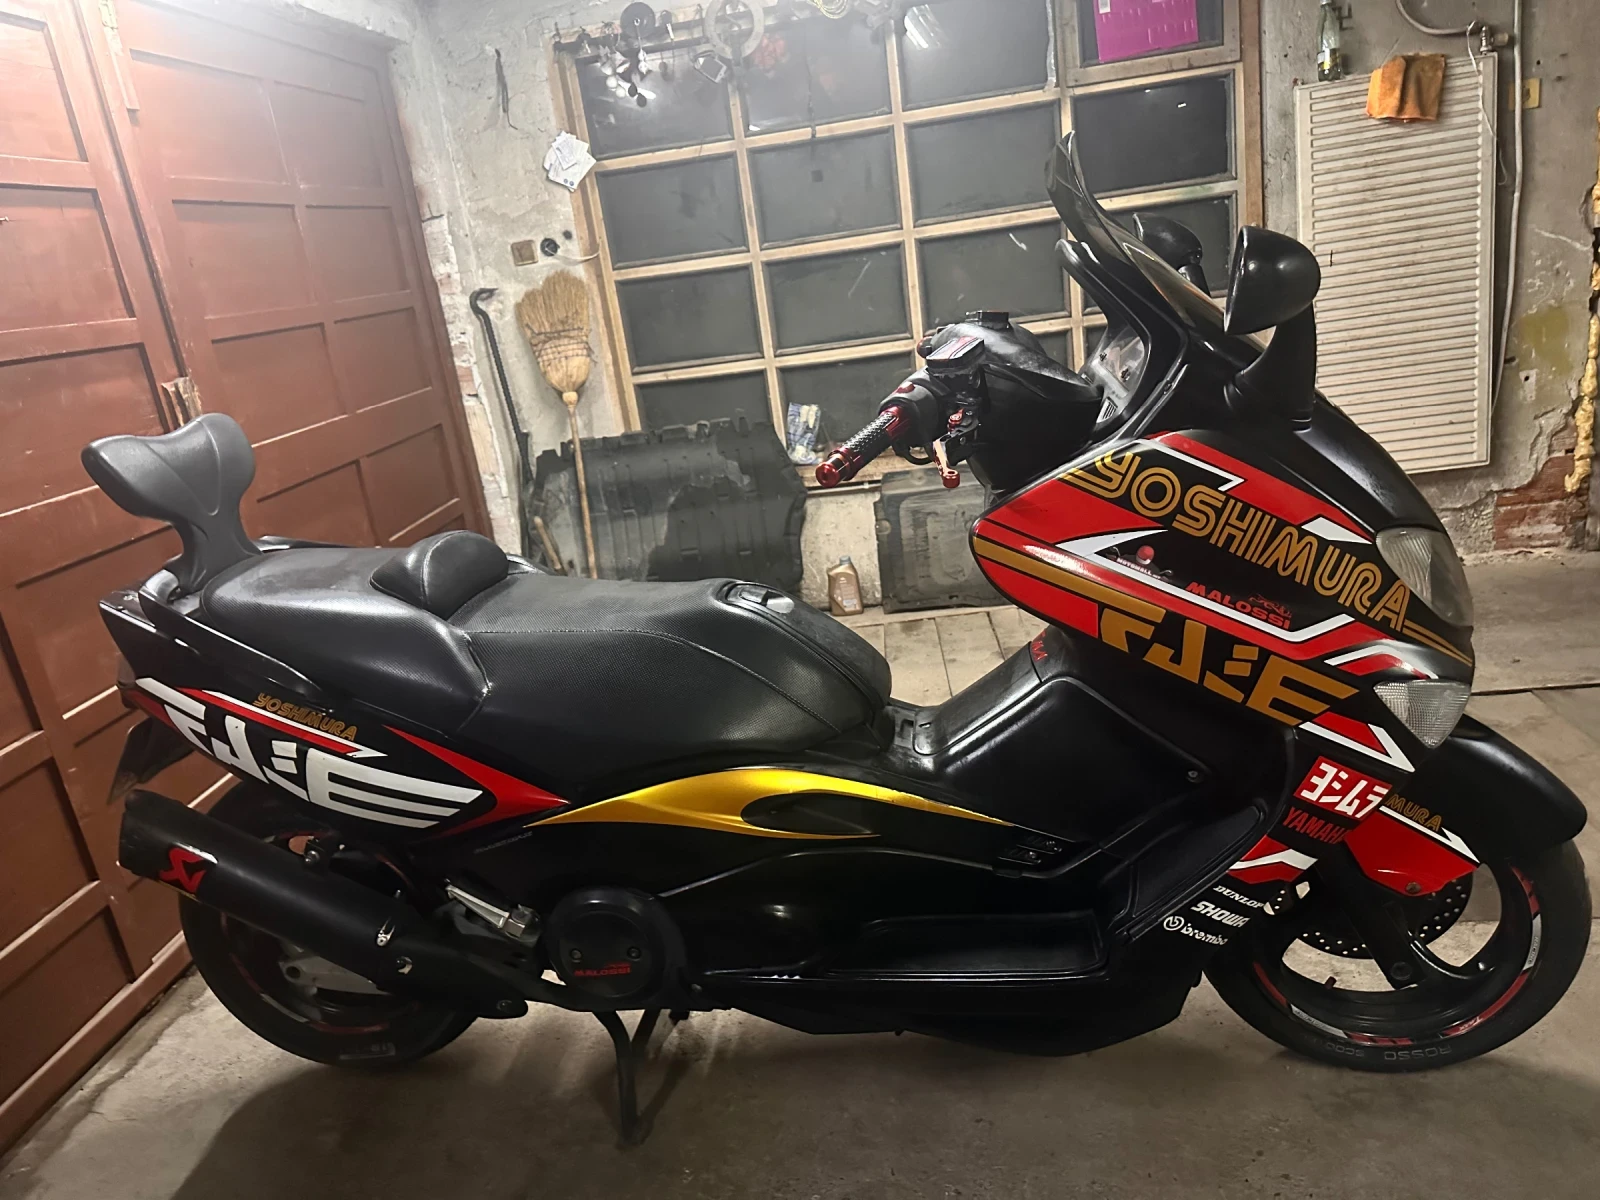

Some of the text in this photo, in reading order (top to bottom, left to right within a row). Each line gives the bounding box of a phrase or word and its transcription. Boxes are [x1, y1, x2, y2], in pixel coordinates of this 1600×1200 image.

[1062, 450, 1413, 631] YOSHIMURA
[1185, 582, 1291, 630] MALOSSI
[252, 692, 358, 741] YOSHIMURA
[1300, 762, 1389, 819] ヨシムラ
[1190, 901, 1250, 928] SHOWA
[1212, 885, 1264, 909] DUNLOP
[1180, 922, 1229, 946] brembo
[1383, 1043, 1453, 1061] ROSSO
